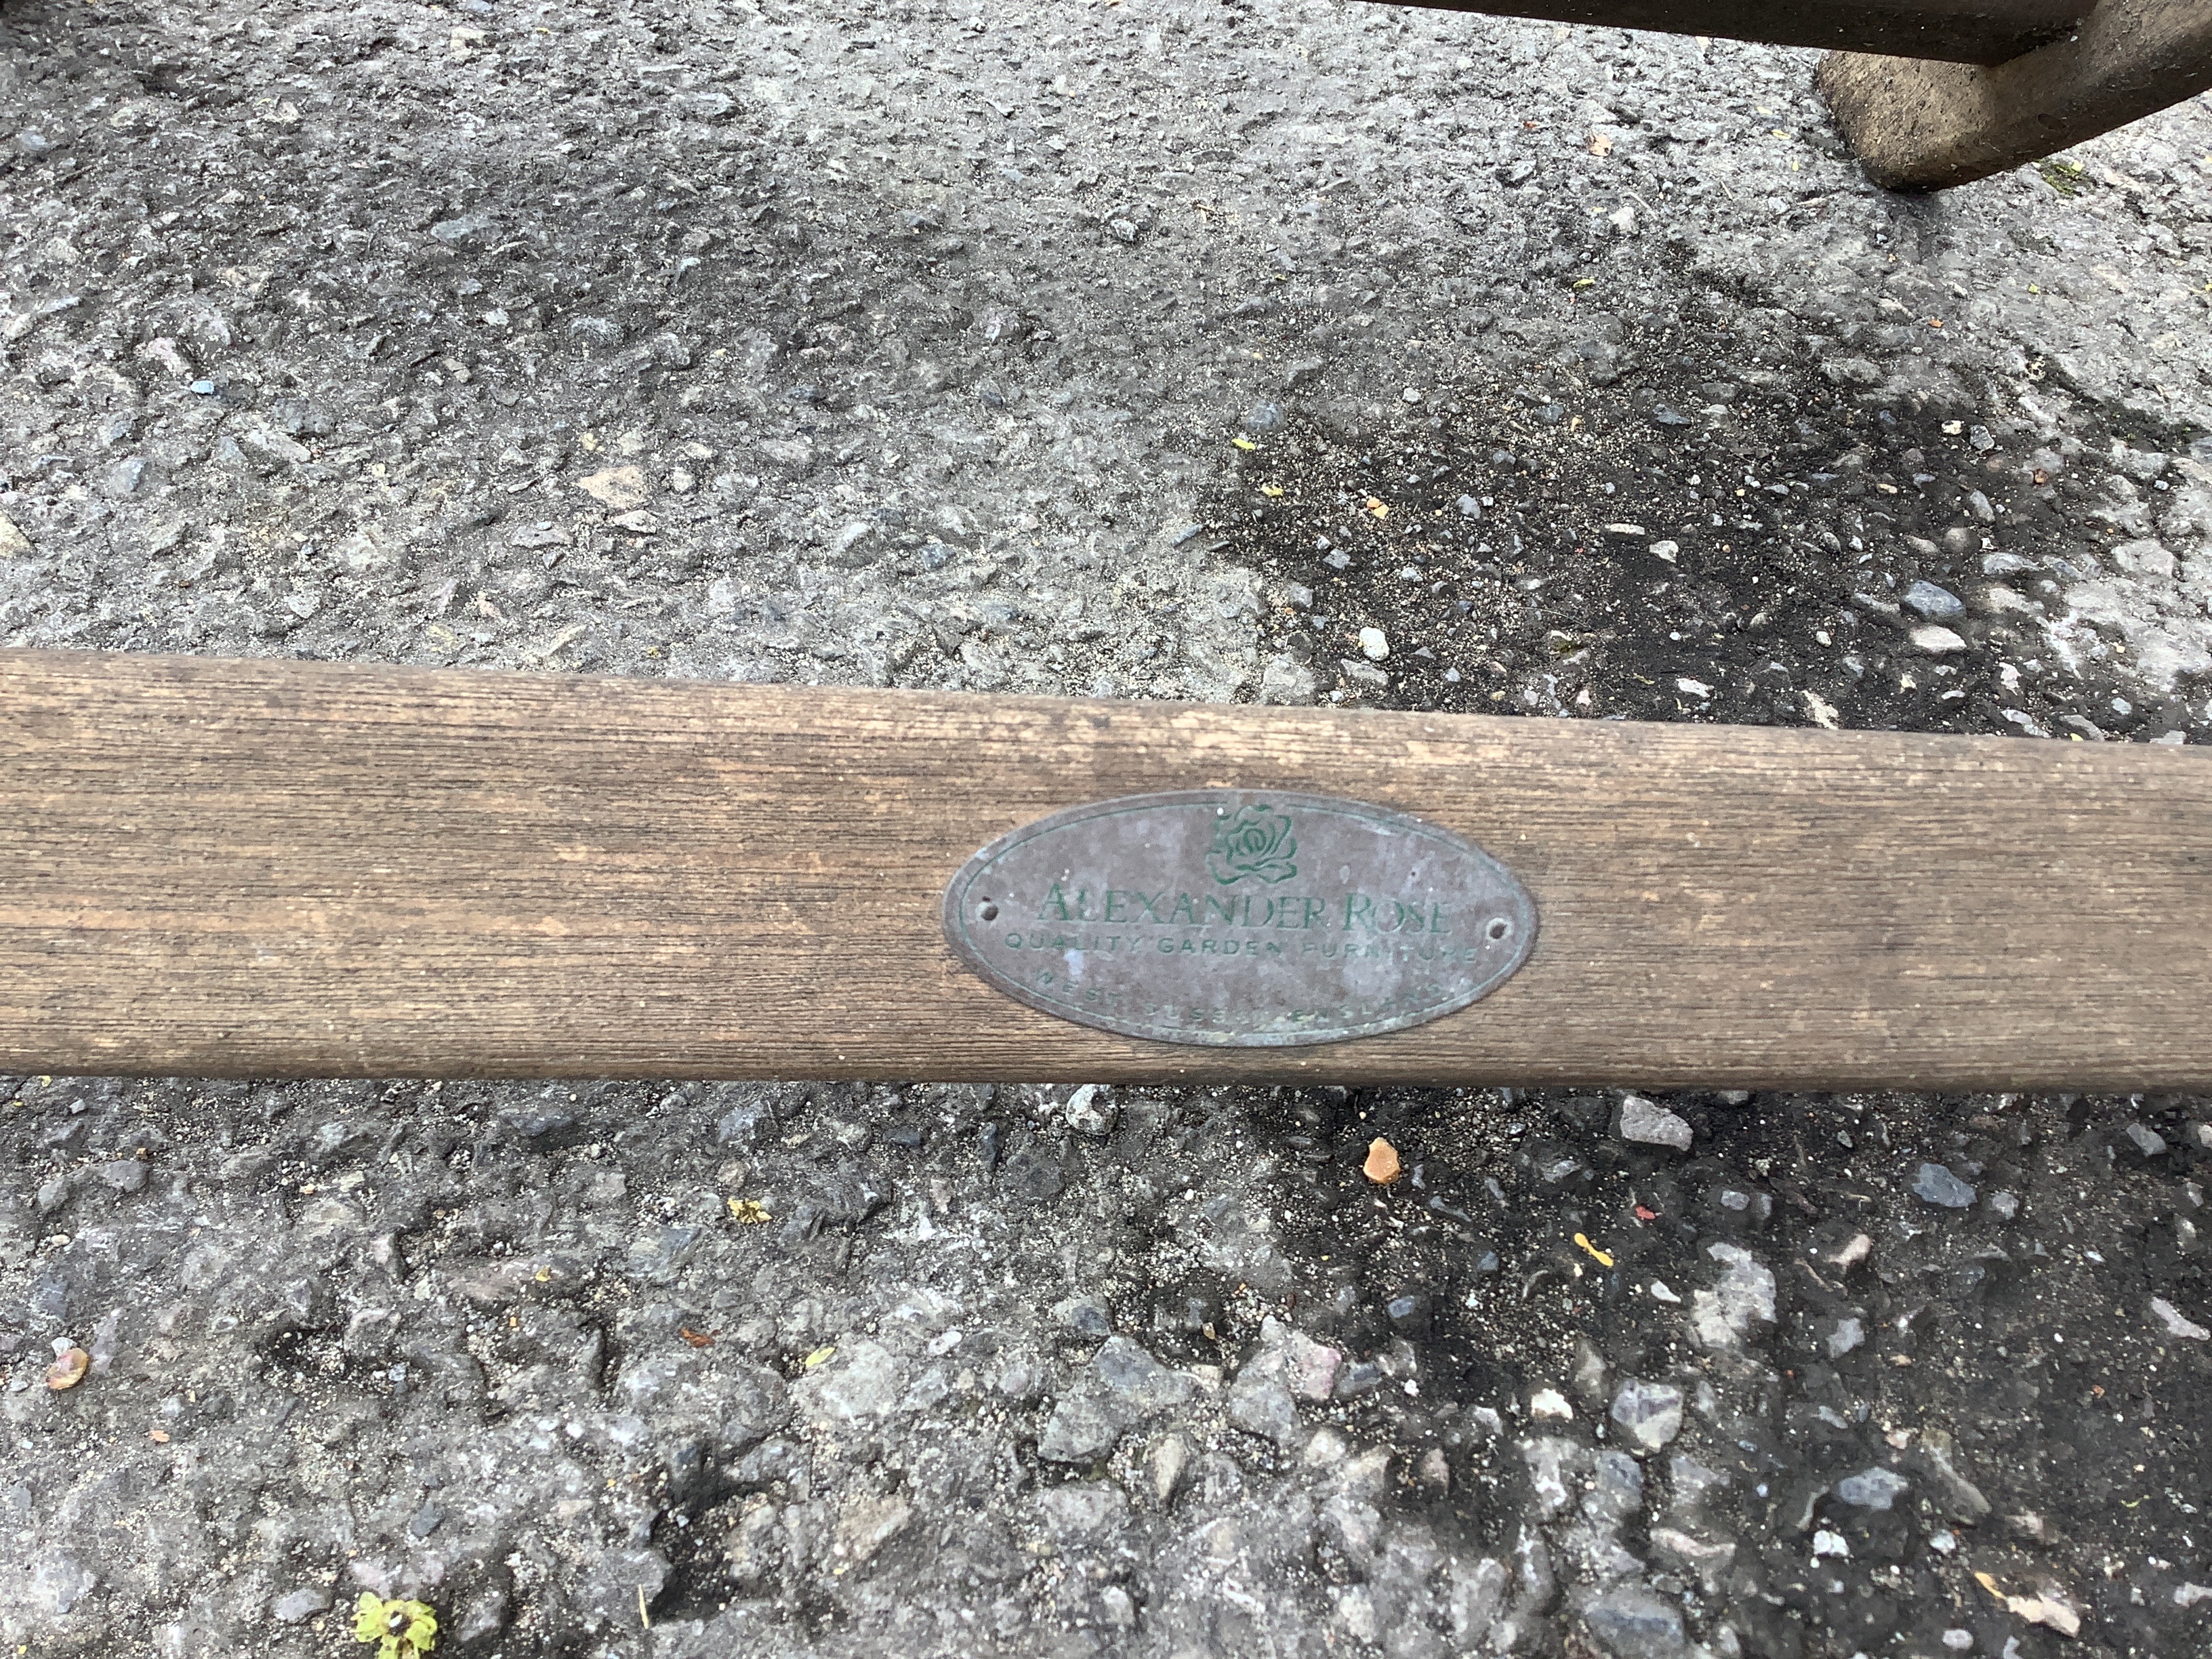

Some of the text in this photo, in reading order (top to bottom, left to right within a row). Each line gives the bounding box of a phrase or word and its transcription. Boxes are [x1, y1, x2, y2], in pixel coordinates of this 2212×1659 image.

[1037, 882, 1452, 934] ALEXANDER ROSE
[1005, 932, 1478, 964] QUALITY GARDEN FURNITURE
[1144, 1002, 1272, 1025] SUSS
